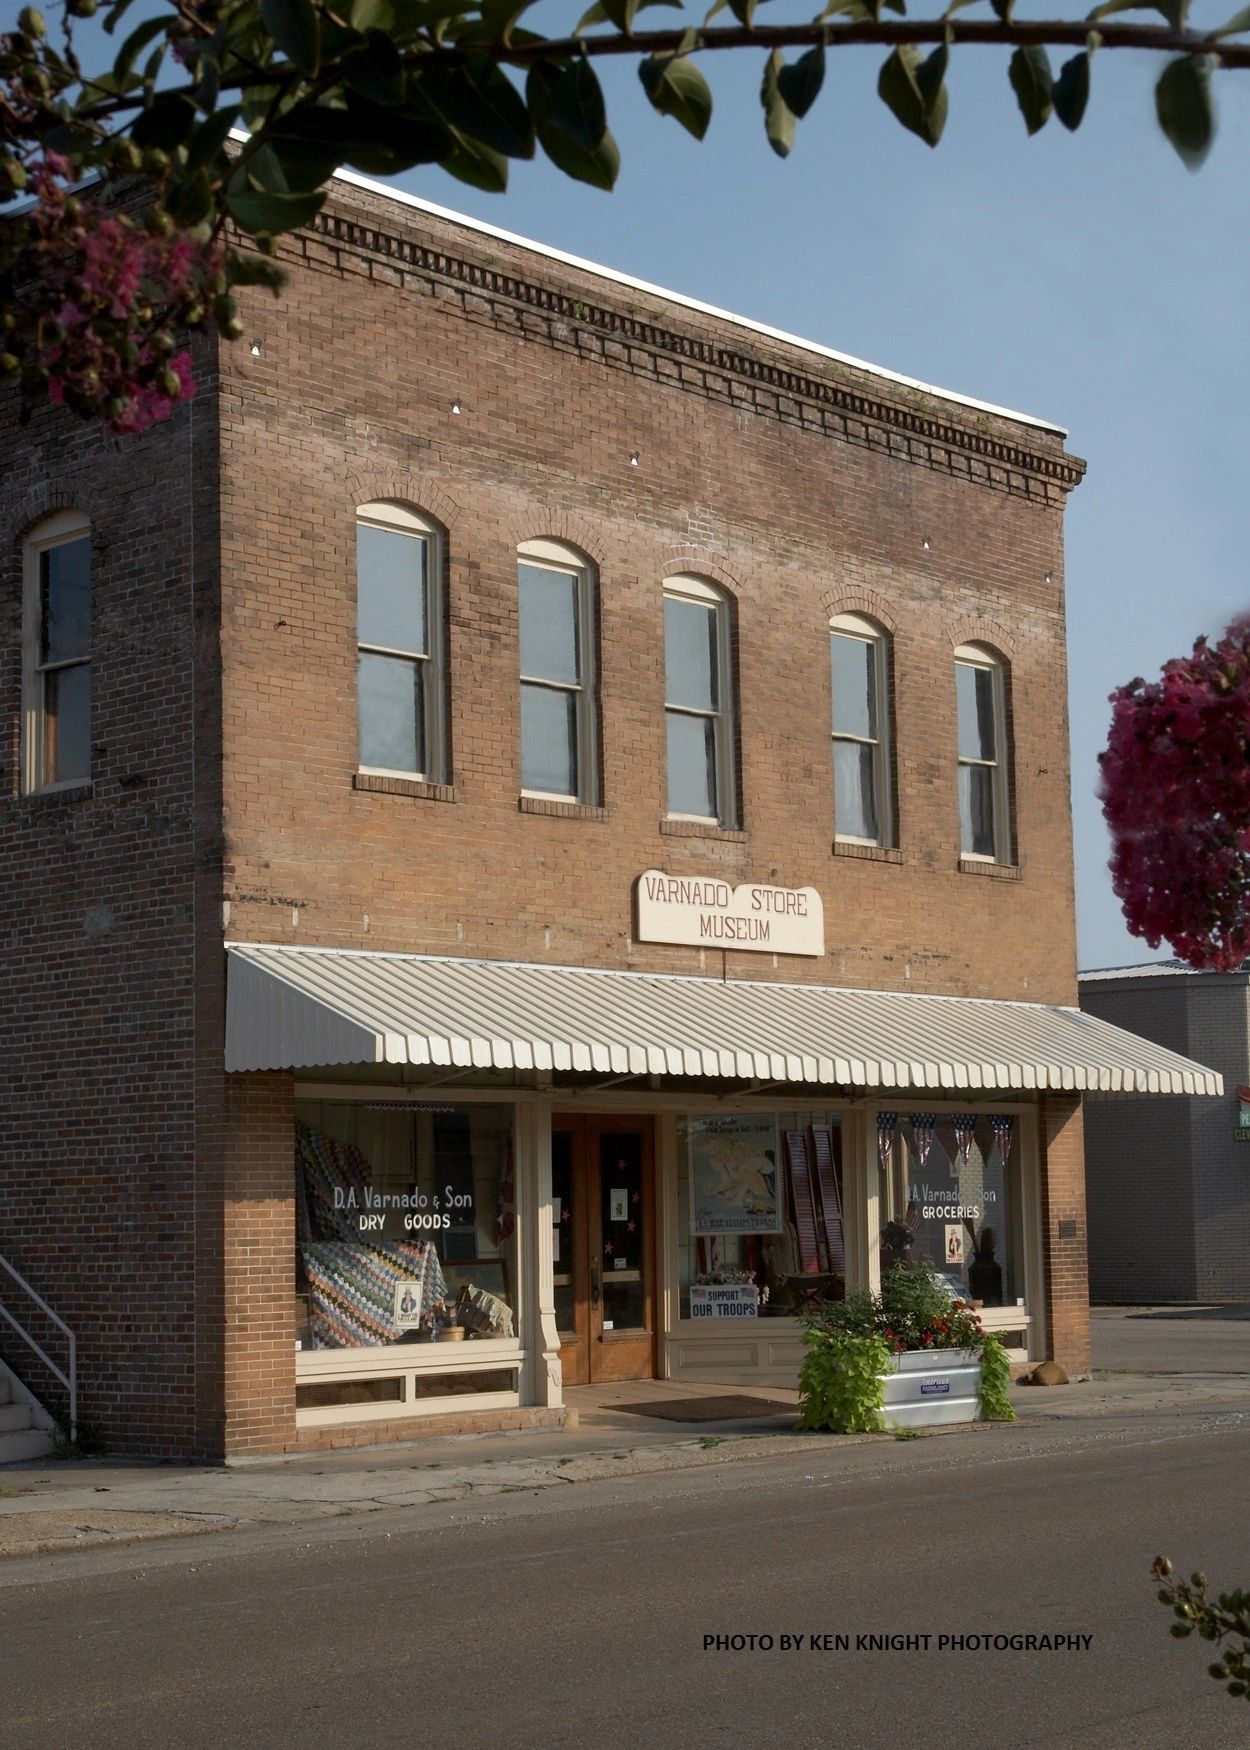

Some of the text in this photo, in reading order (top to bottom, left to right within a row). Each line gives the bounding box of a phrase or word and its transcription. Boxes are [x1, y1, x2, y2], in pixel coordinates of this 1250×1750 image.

[645, 876, 808, 917] VARNADO STORE
[700, 913, 770, 941] MUSEUM
[334, 1185, 472, 1210] D.A. Varnado & Son
[921, 1184, 964, 1202] Varnado
[976, 1184, 996, 1202] Son
[922, 1205, 980, 1219] GROCERIES
[359, 1213, 451, 1231] DRY GOODS
[707, 1290, 739, 1302] SUPPORT
[692, 1302, 756, 1317] OUR TROOPS
